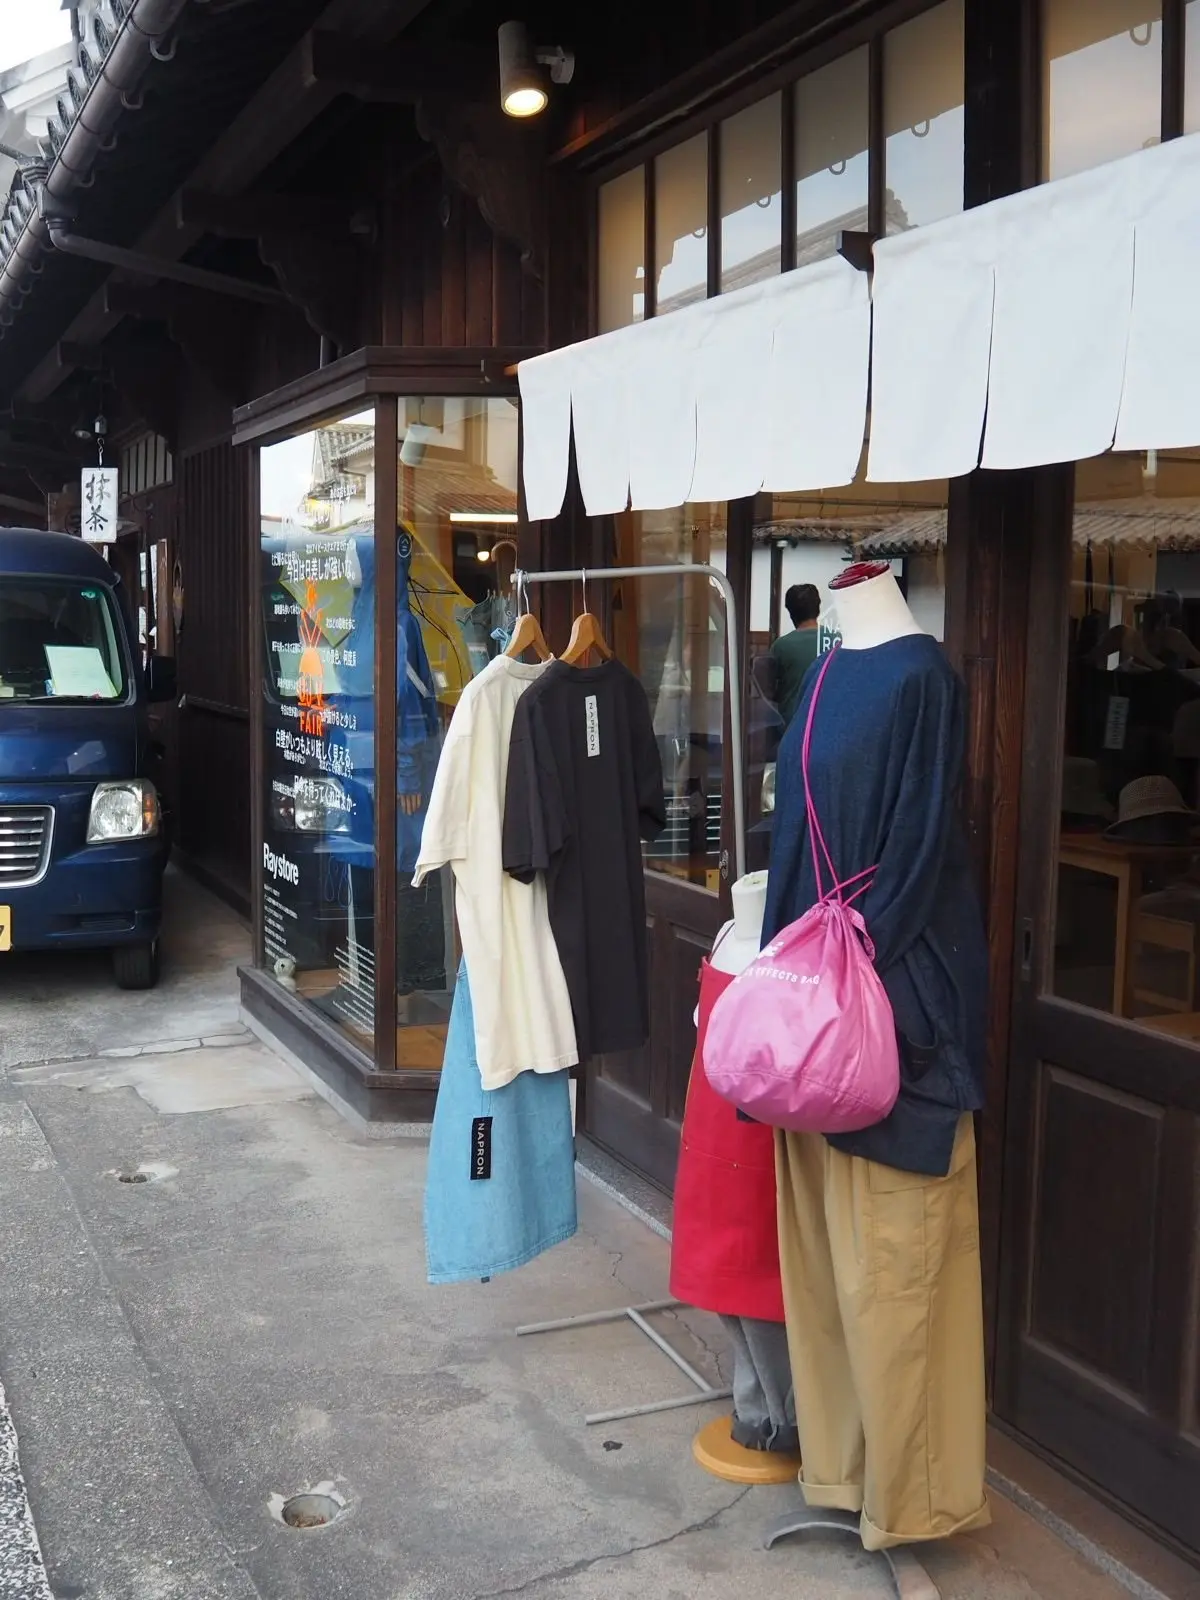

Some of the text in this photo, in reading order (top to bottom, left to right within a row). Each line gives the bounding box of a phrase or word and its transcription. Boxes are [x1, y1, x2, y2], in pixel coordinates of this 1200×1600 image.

[85, 473, 111, 532] 抹茶
[301, 710, 323, 737] FAIR
[588, 702, 596, 751] NAPRON
[476, 1122, 485, 1175] NAPRON
